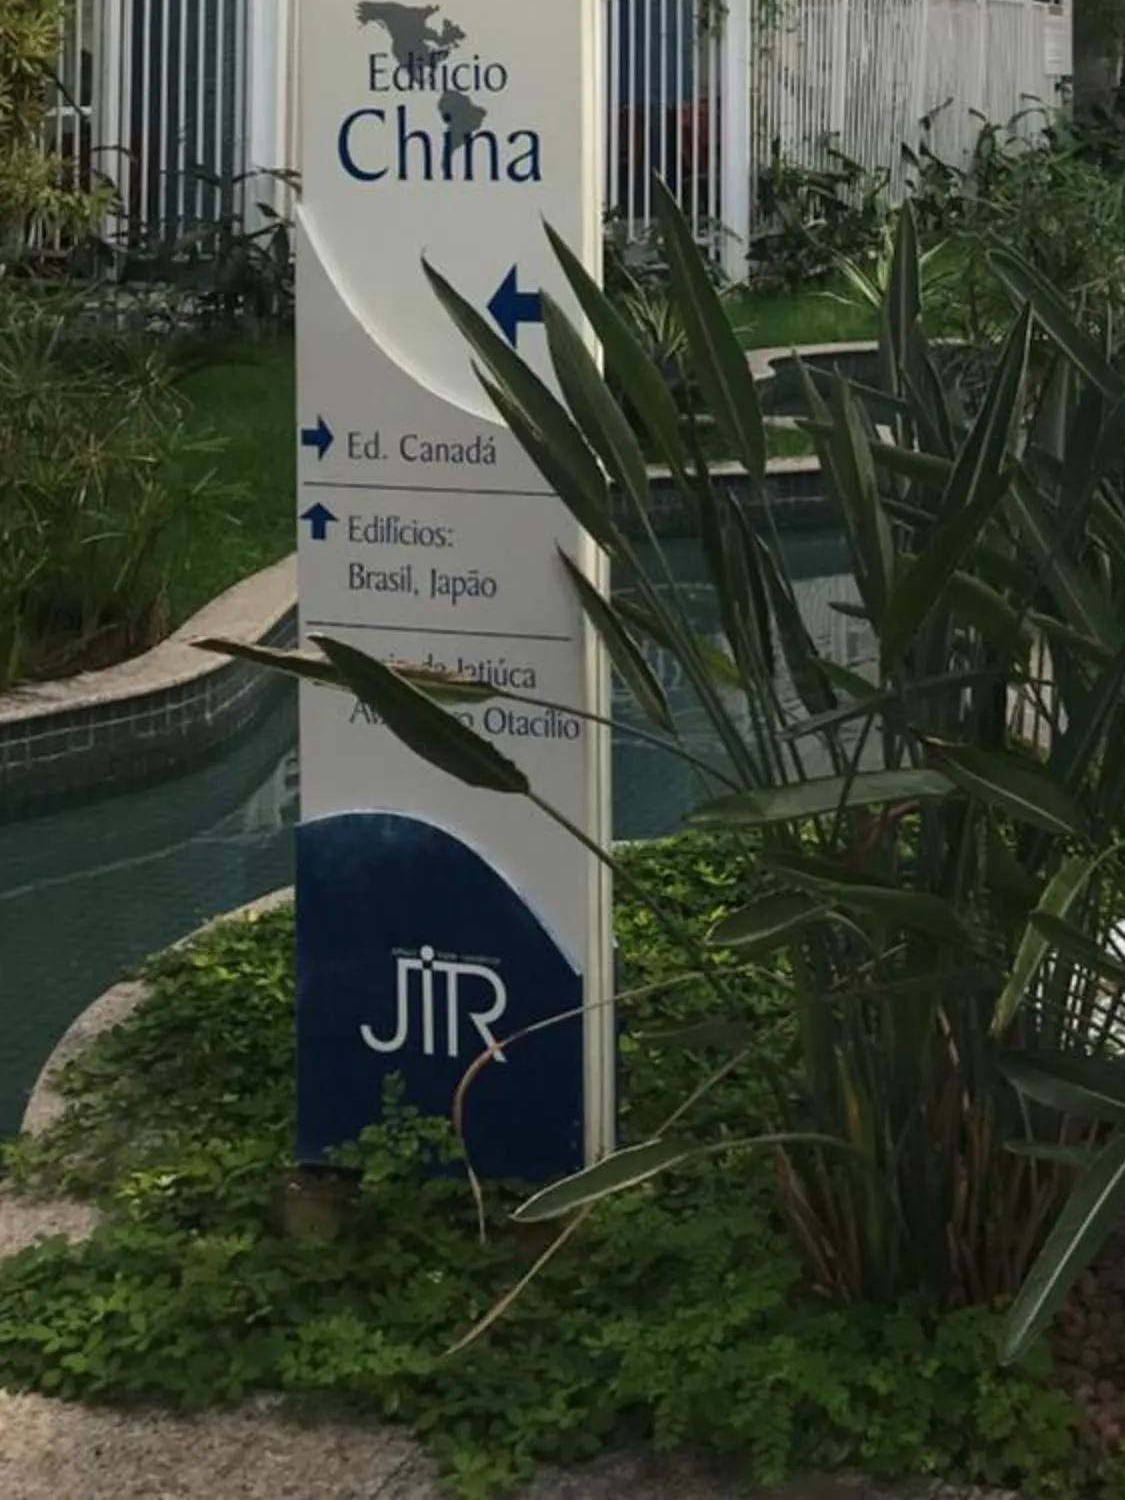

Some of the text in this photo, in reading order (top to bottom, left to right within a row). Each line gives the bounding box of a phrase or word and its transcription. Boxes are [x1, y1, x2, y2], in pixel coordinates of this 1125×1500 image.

[337, 105, 542, 183] China
[347, 430, 497, 465] Ed. Canadá
[430, 567, 498, 606] Japão
